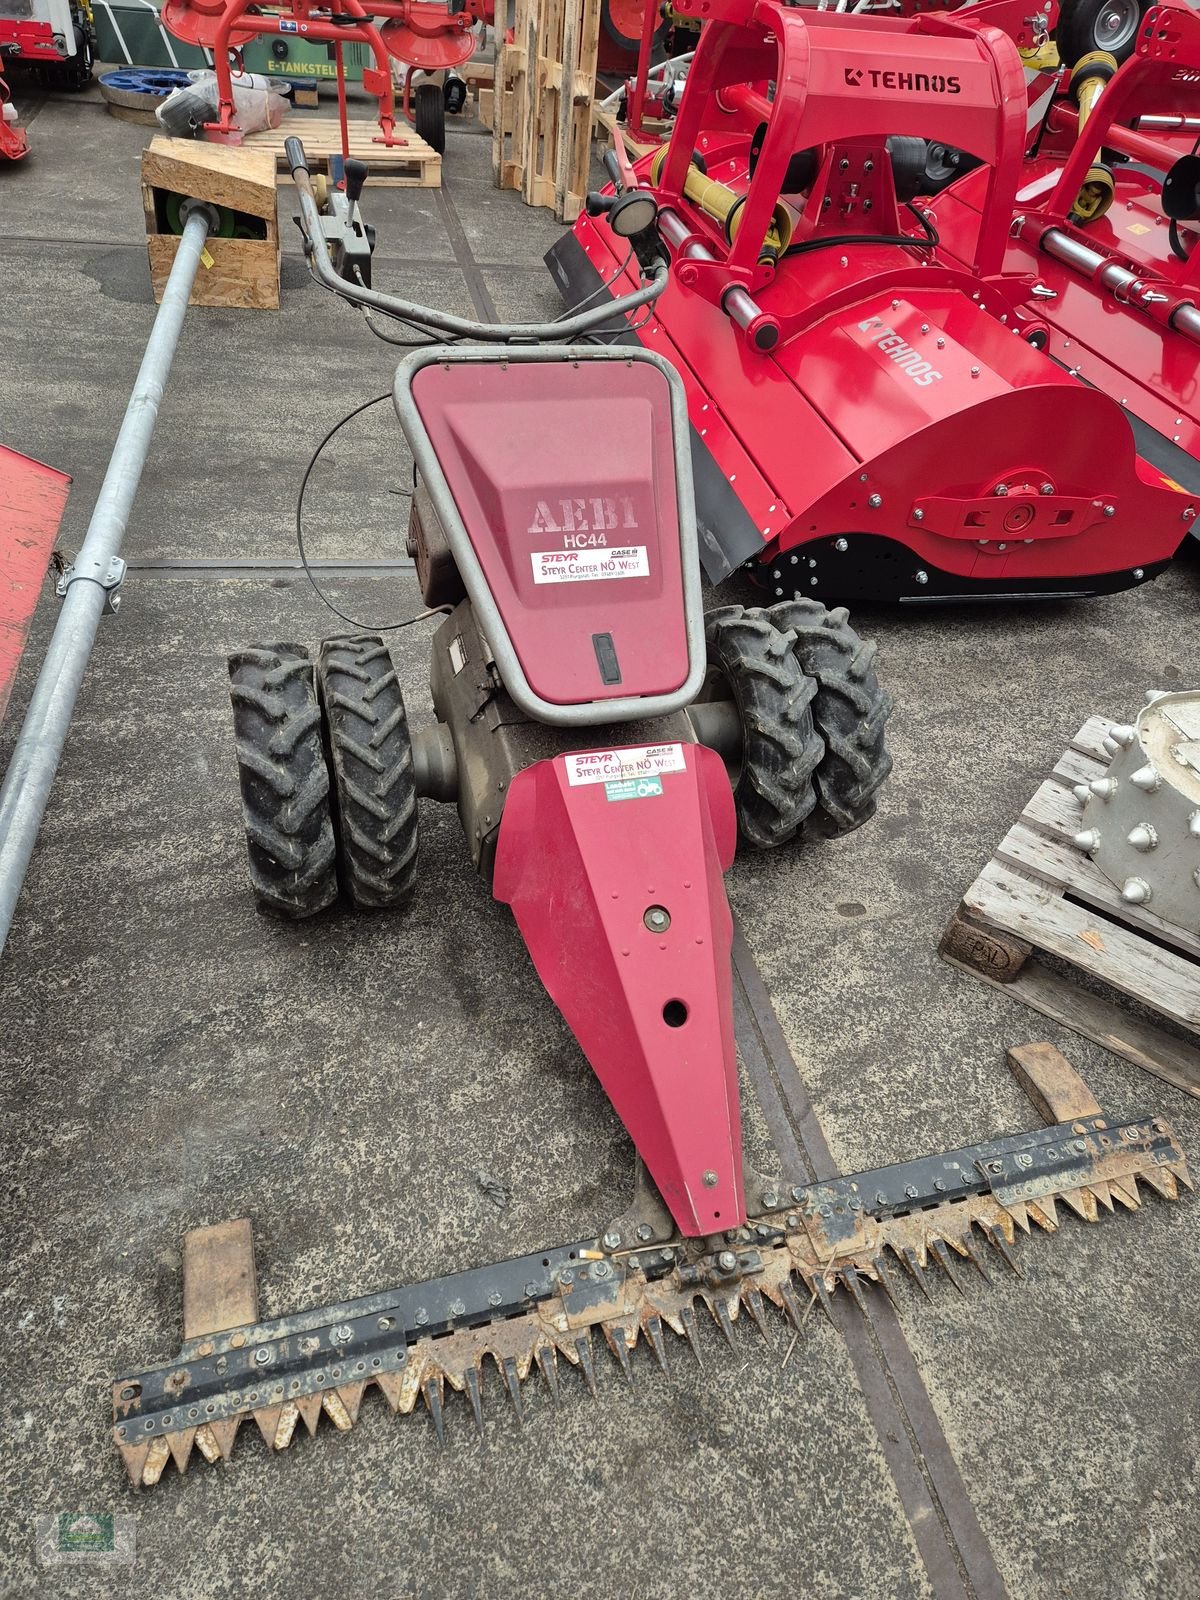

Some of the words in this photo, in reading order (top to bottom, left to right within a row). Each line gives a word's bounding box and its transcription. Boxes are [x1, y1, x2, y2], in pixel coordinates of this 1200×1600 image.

[868, 70, 961, 94] TEHNOS
[871, 327, 943, 386] TEHNOS
[527, 497, 638, 533] AEBI
[563, 533, 607, 548] HC44
[541, 553, 578, 563] STEYR
[600, 559, 616, 571] NÖ
[646, 747, 666, 755] CASE
[576, 754, 613, 765] STEYR
[636, 758, 652, 771] NÖ
